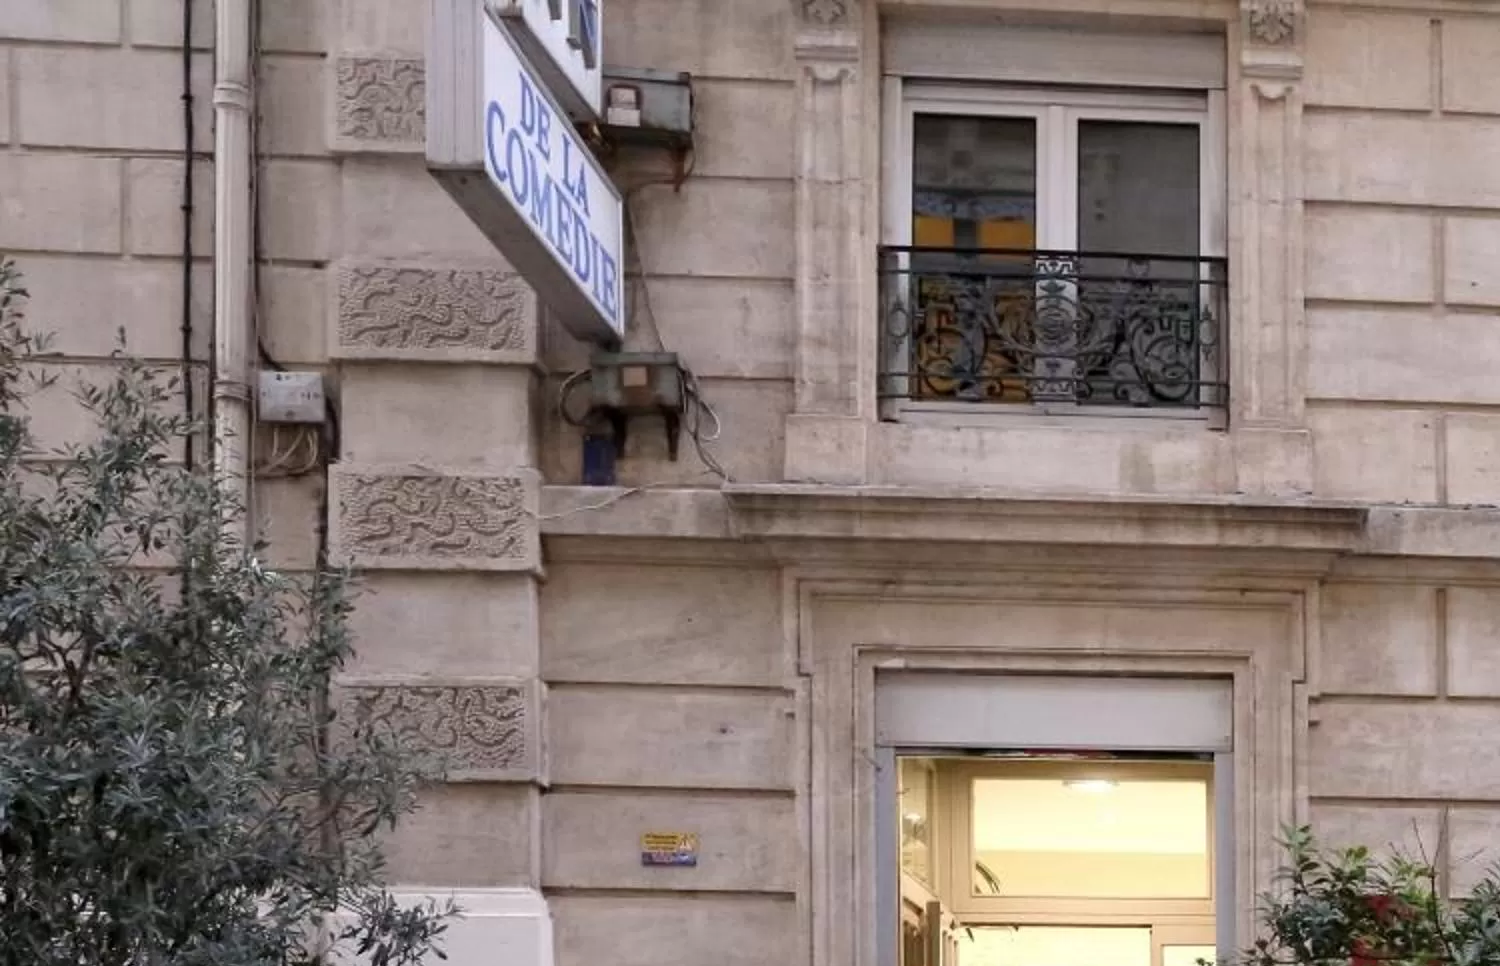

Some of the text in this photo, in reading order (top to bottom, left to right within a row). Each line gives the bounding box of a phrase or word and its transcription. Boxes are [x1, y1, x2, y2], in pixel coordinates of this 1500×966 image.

[486, 100, 617, 322] COMEDIE
[519, 71, 591, 219] DE LA
